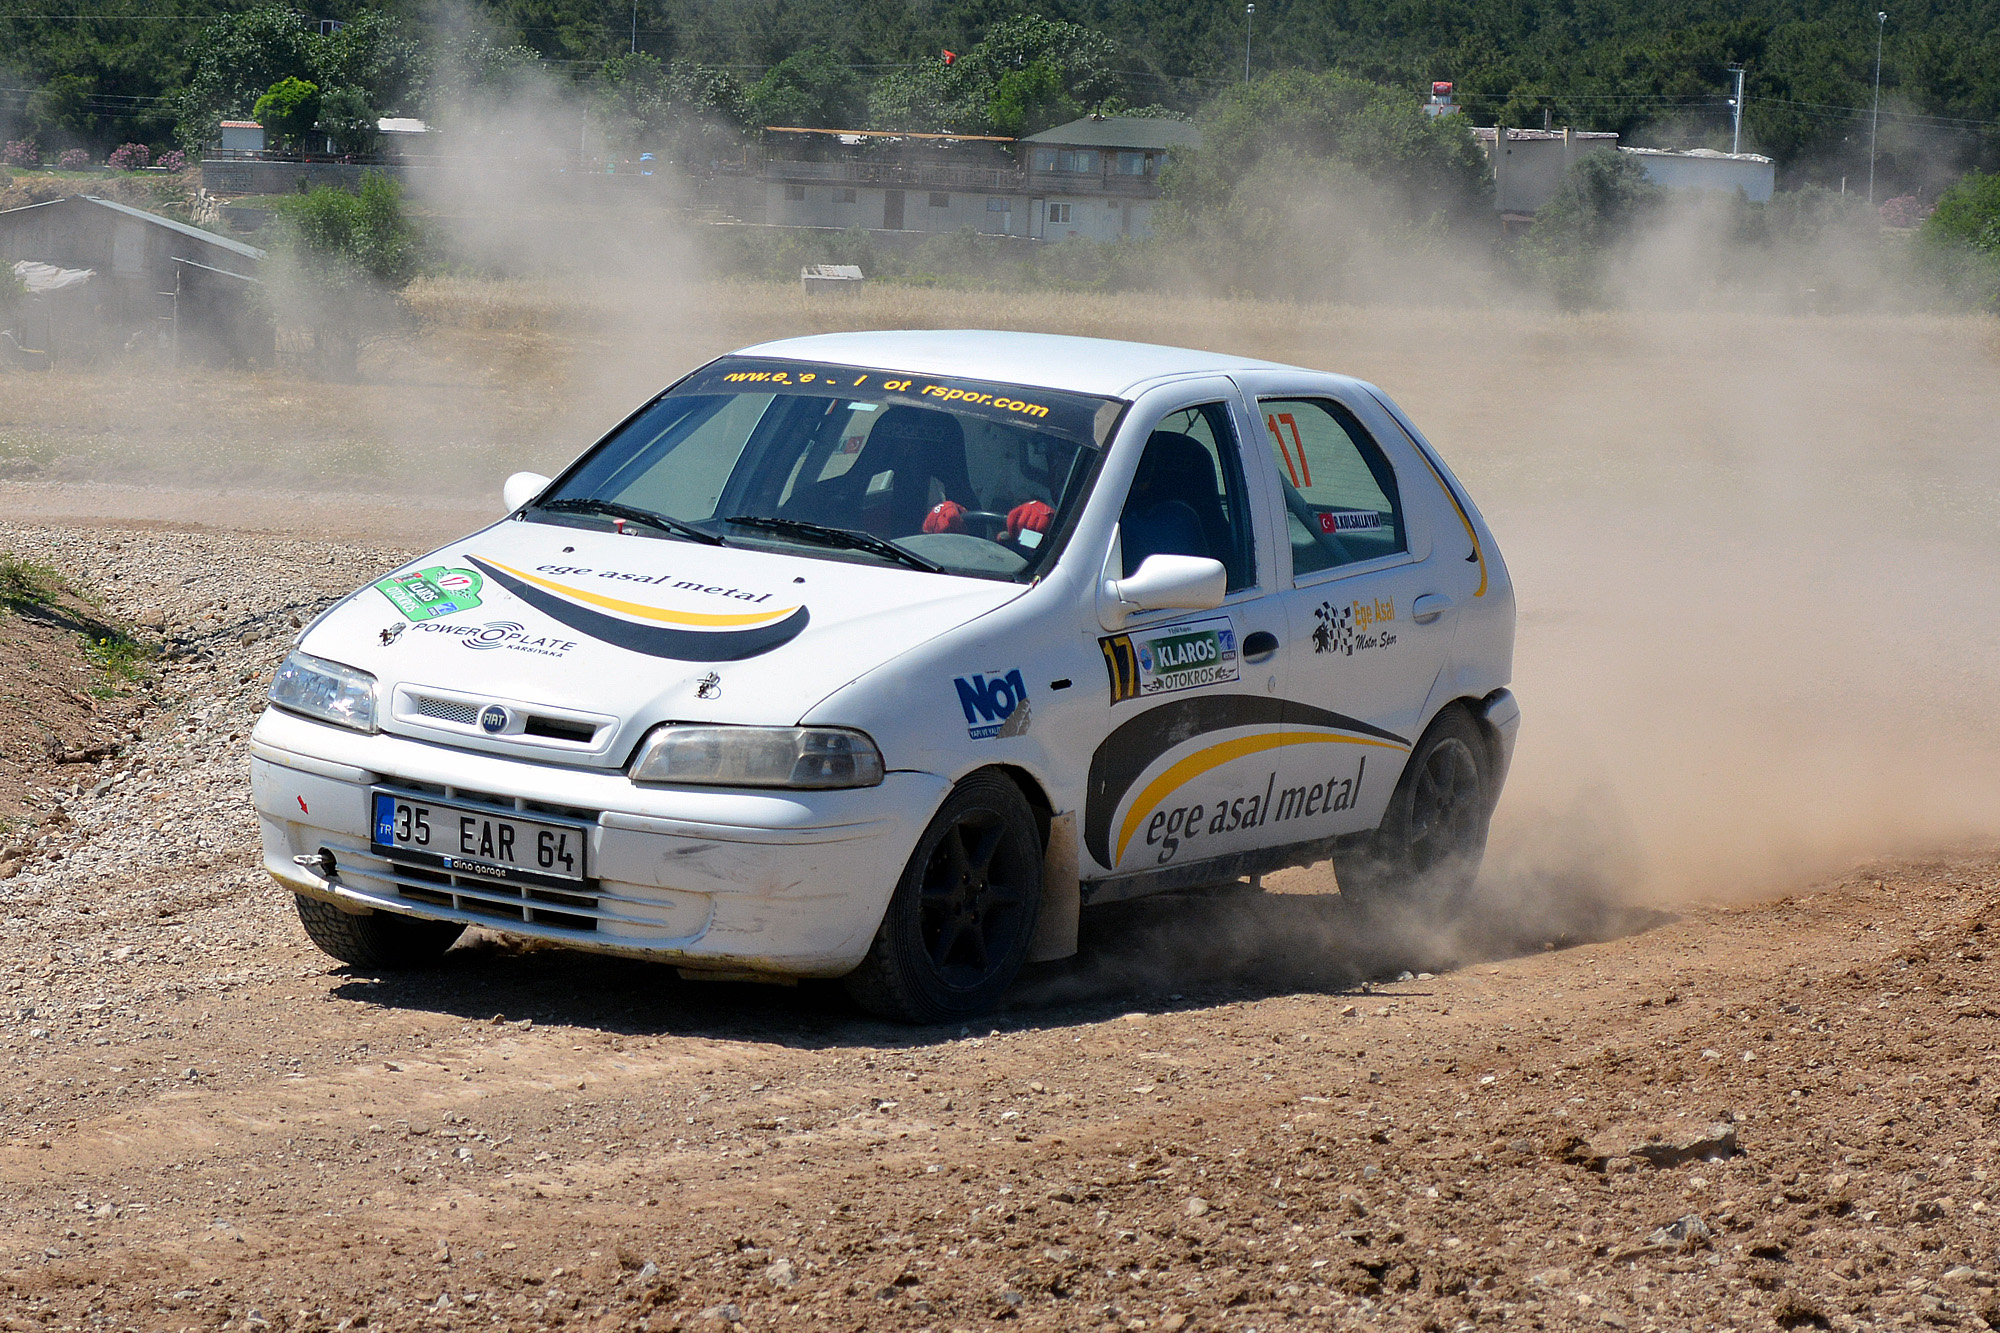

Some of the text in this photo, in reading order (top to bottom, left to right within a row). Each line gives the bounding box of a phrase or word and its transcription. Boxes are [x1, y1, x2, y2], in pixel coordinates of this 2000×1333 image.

[1267, 413, 1312, 488] 17
[536, 563, 773, 604] ege asal metal
[1352, 595, 1395, 632] Ege Asal
[1156, 637, 1217, 669] KLAROS
[1355, 631, 1397, 651] Motor Spor
[1103, 635, 1135, 700] 17
[1164, 666, 1214, 690] OTOKROS
[483, 712, 505, 727] FIAT
[1146, 755, 1367, 864] ege asal metal
[379, 822, 392, 836] TR
[395, 804, 574, 872] 35 EAR 64
[453, 859, 507, 878] dino garage
